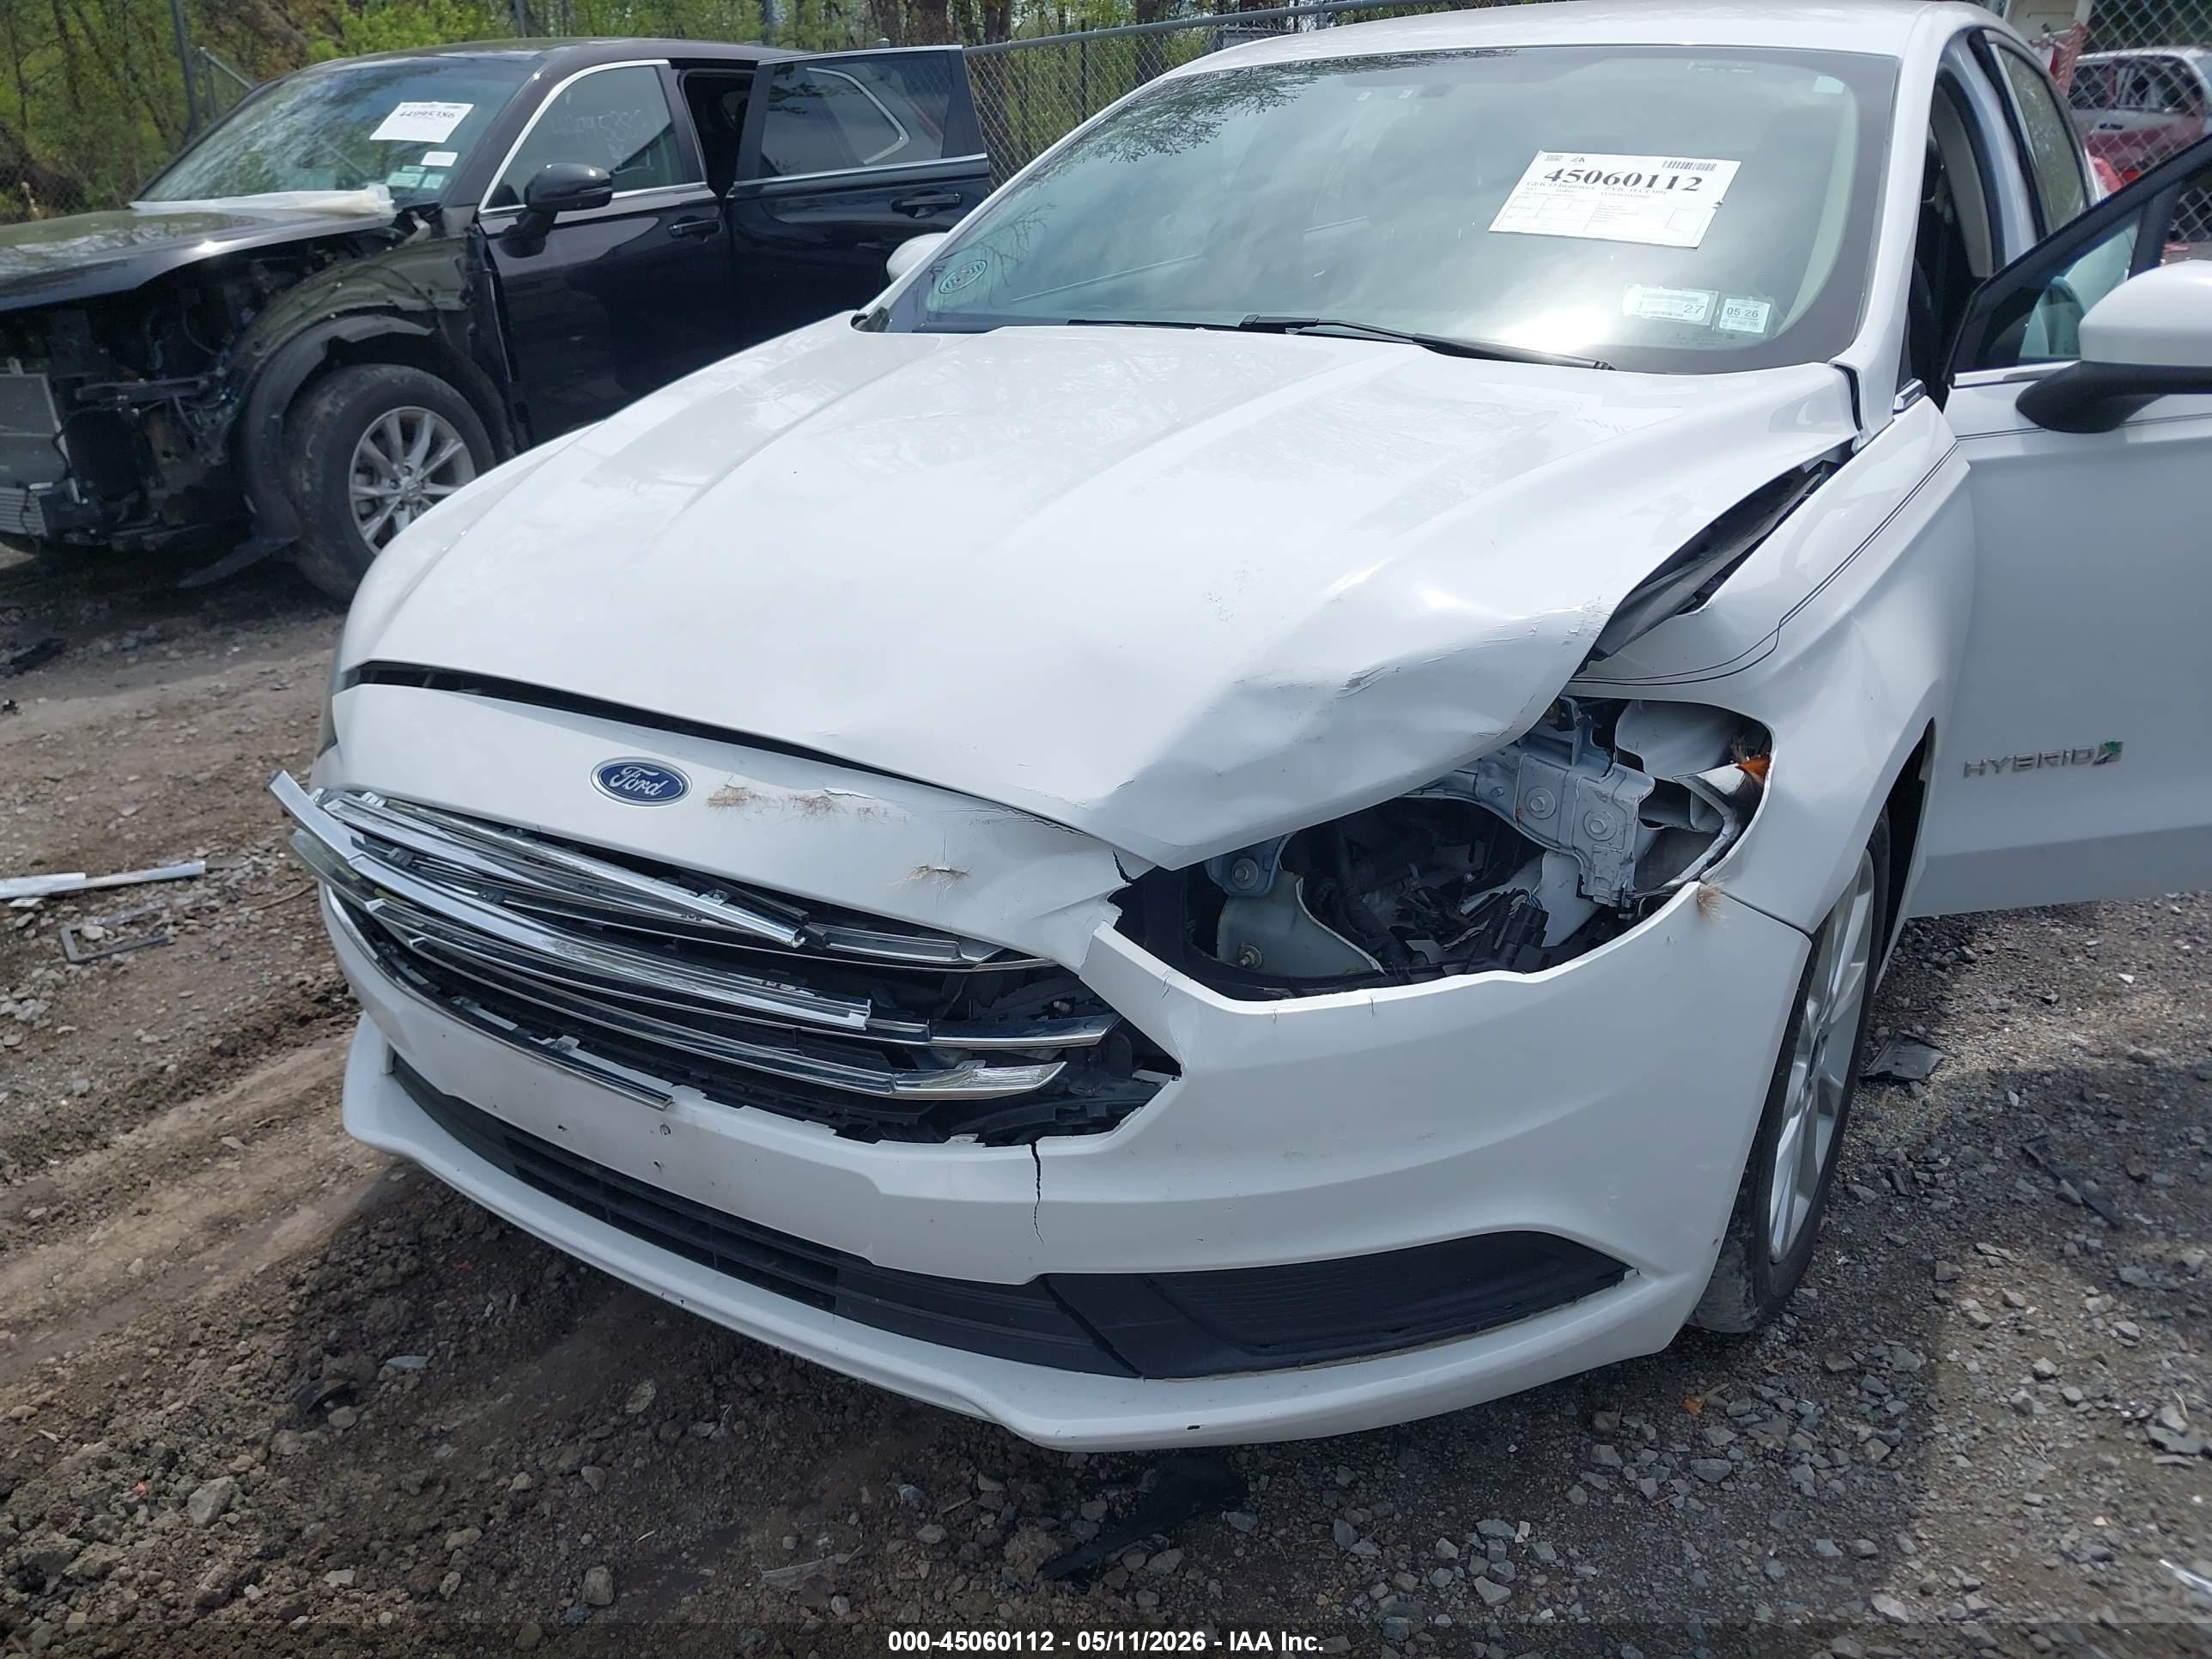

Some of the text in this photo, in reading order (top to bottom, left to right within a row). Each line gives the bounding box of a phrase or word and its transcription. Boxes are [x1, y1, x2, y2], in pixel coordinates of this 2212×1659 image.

[1544, 168, 1703, 191] 45060112
[1684, 304, 1705, 314] 27
[1726, 307, 1759, 319] 05 26
[1963, 747, 2095, 778] HYBRID
[610, 766, 669, 796] Ford
